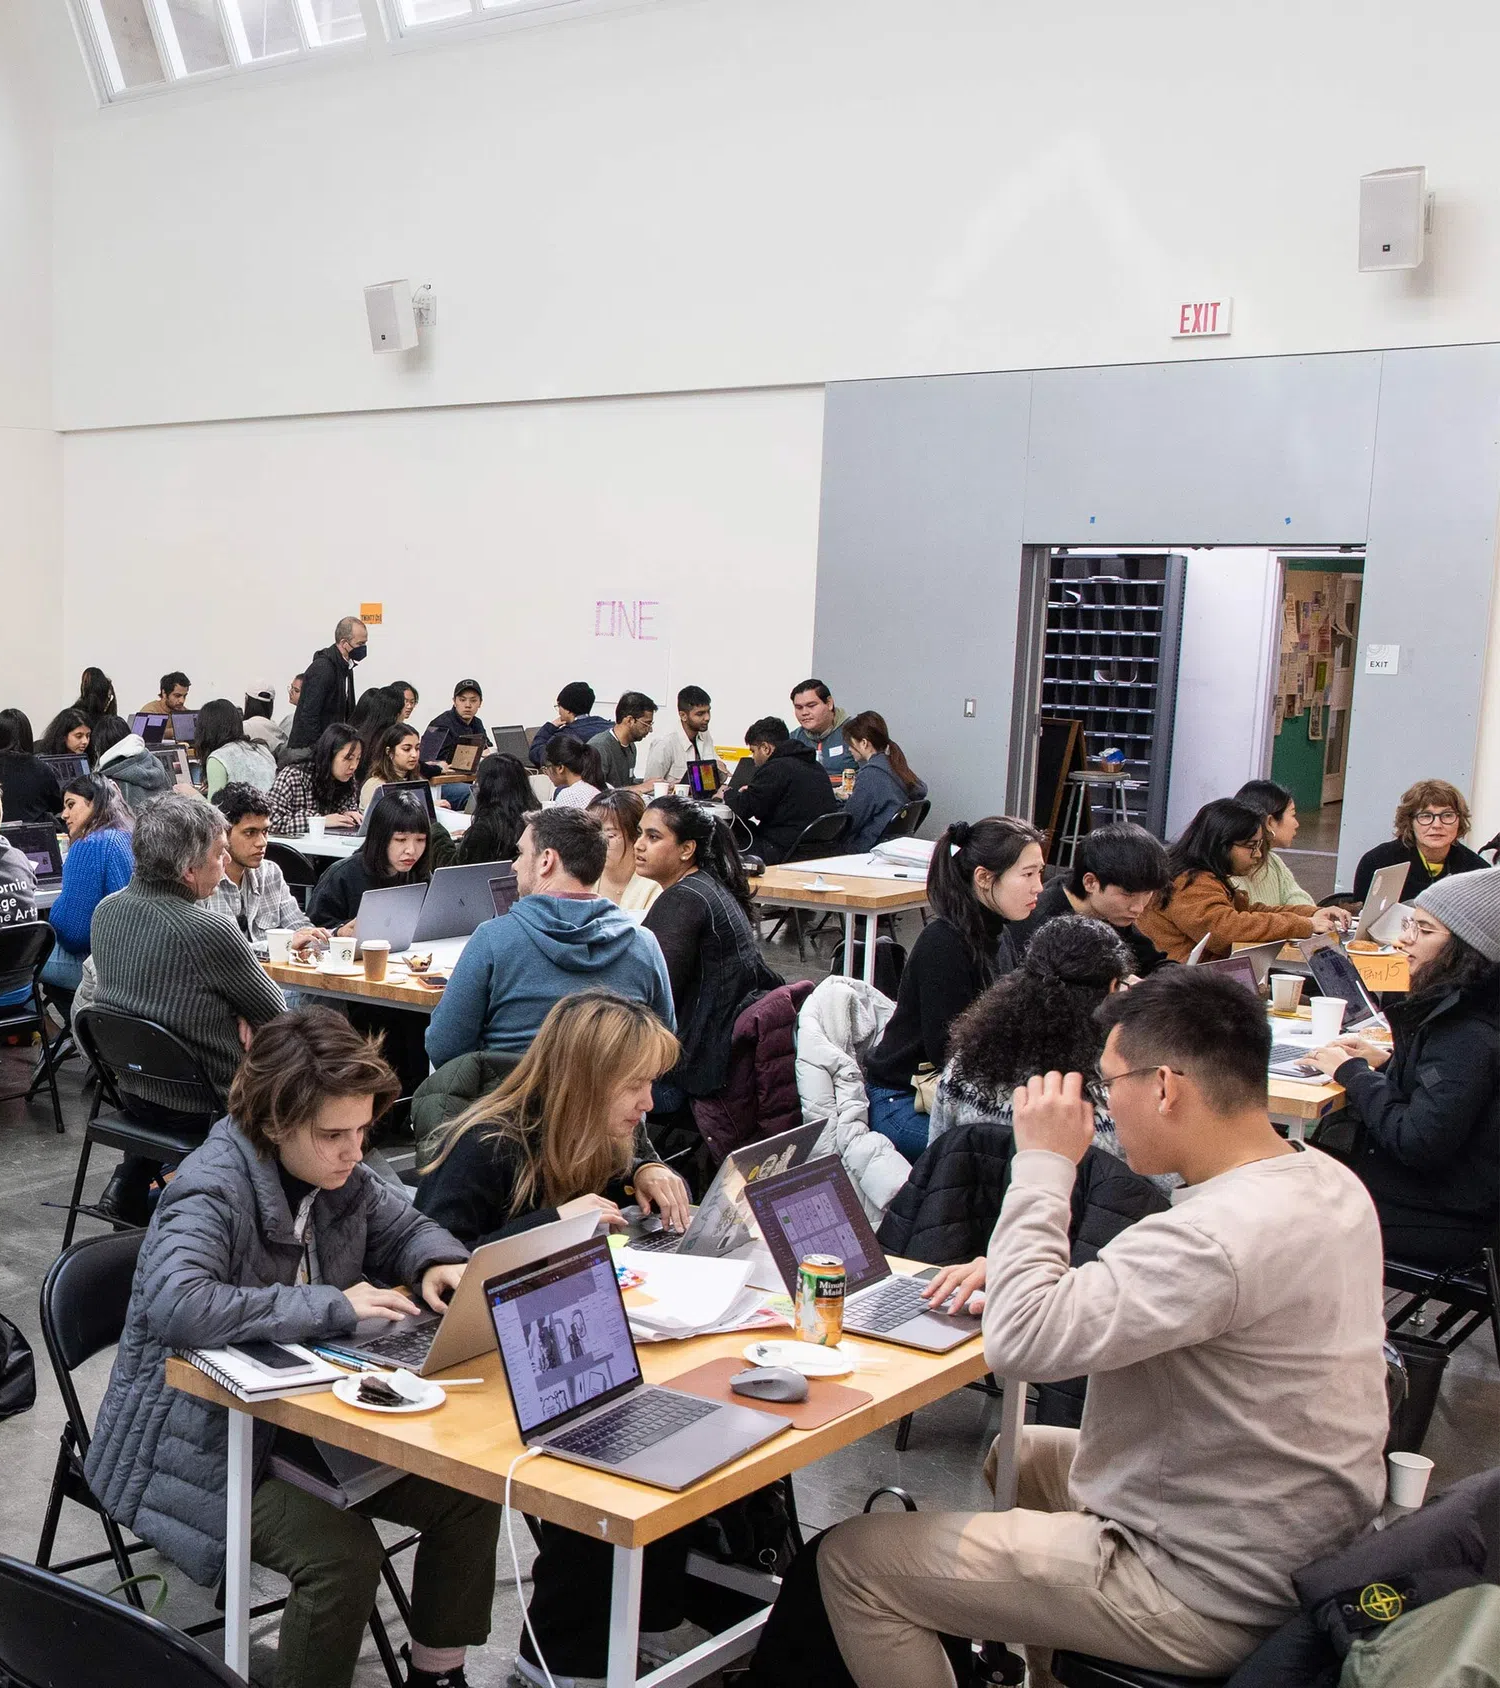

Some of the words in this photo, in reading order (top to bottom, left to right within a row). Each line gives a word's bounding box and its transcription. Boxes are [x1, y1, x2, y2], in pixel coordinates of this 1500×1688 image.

[1180, 303, 1220, 333] EXIT
[595, 601, 659, 639] ONE
[1370, 660, 1388, 668] EXIT
[1360, 967, 1382, 980] TEAM
[1385, 962, 1404, 981] 15
[822, 1288, 842, 1296] Maid
